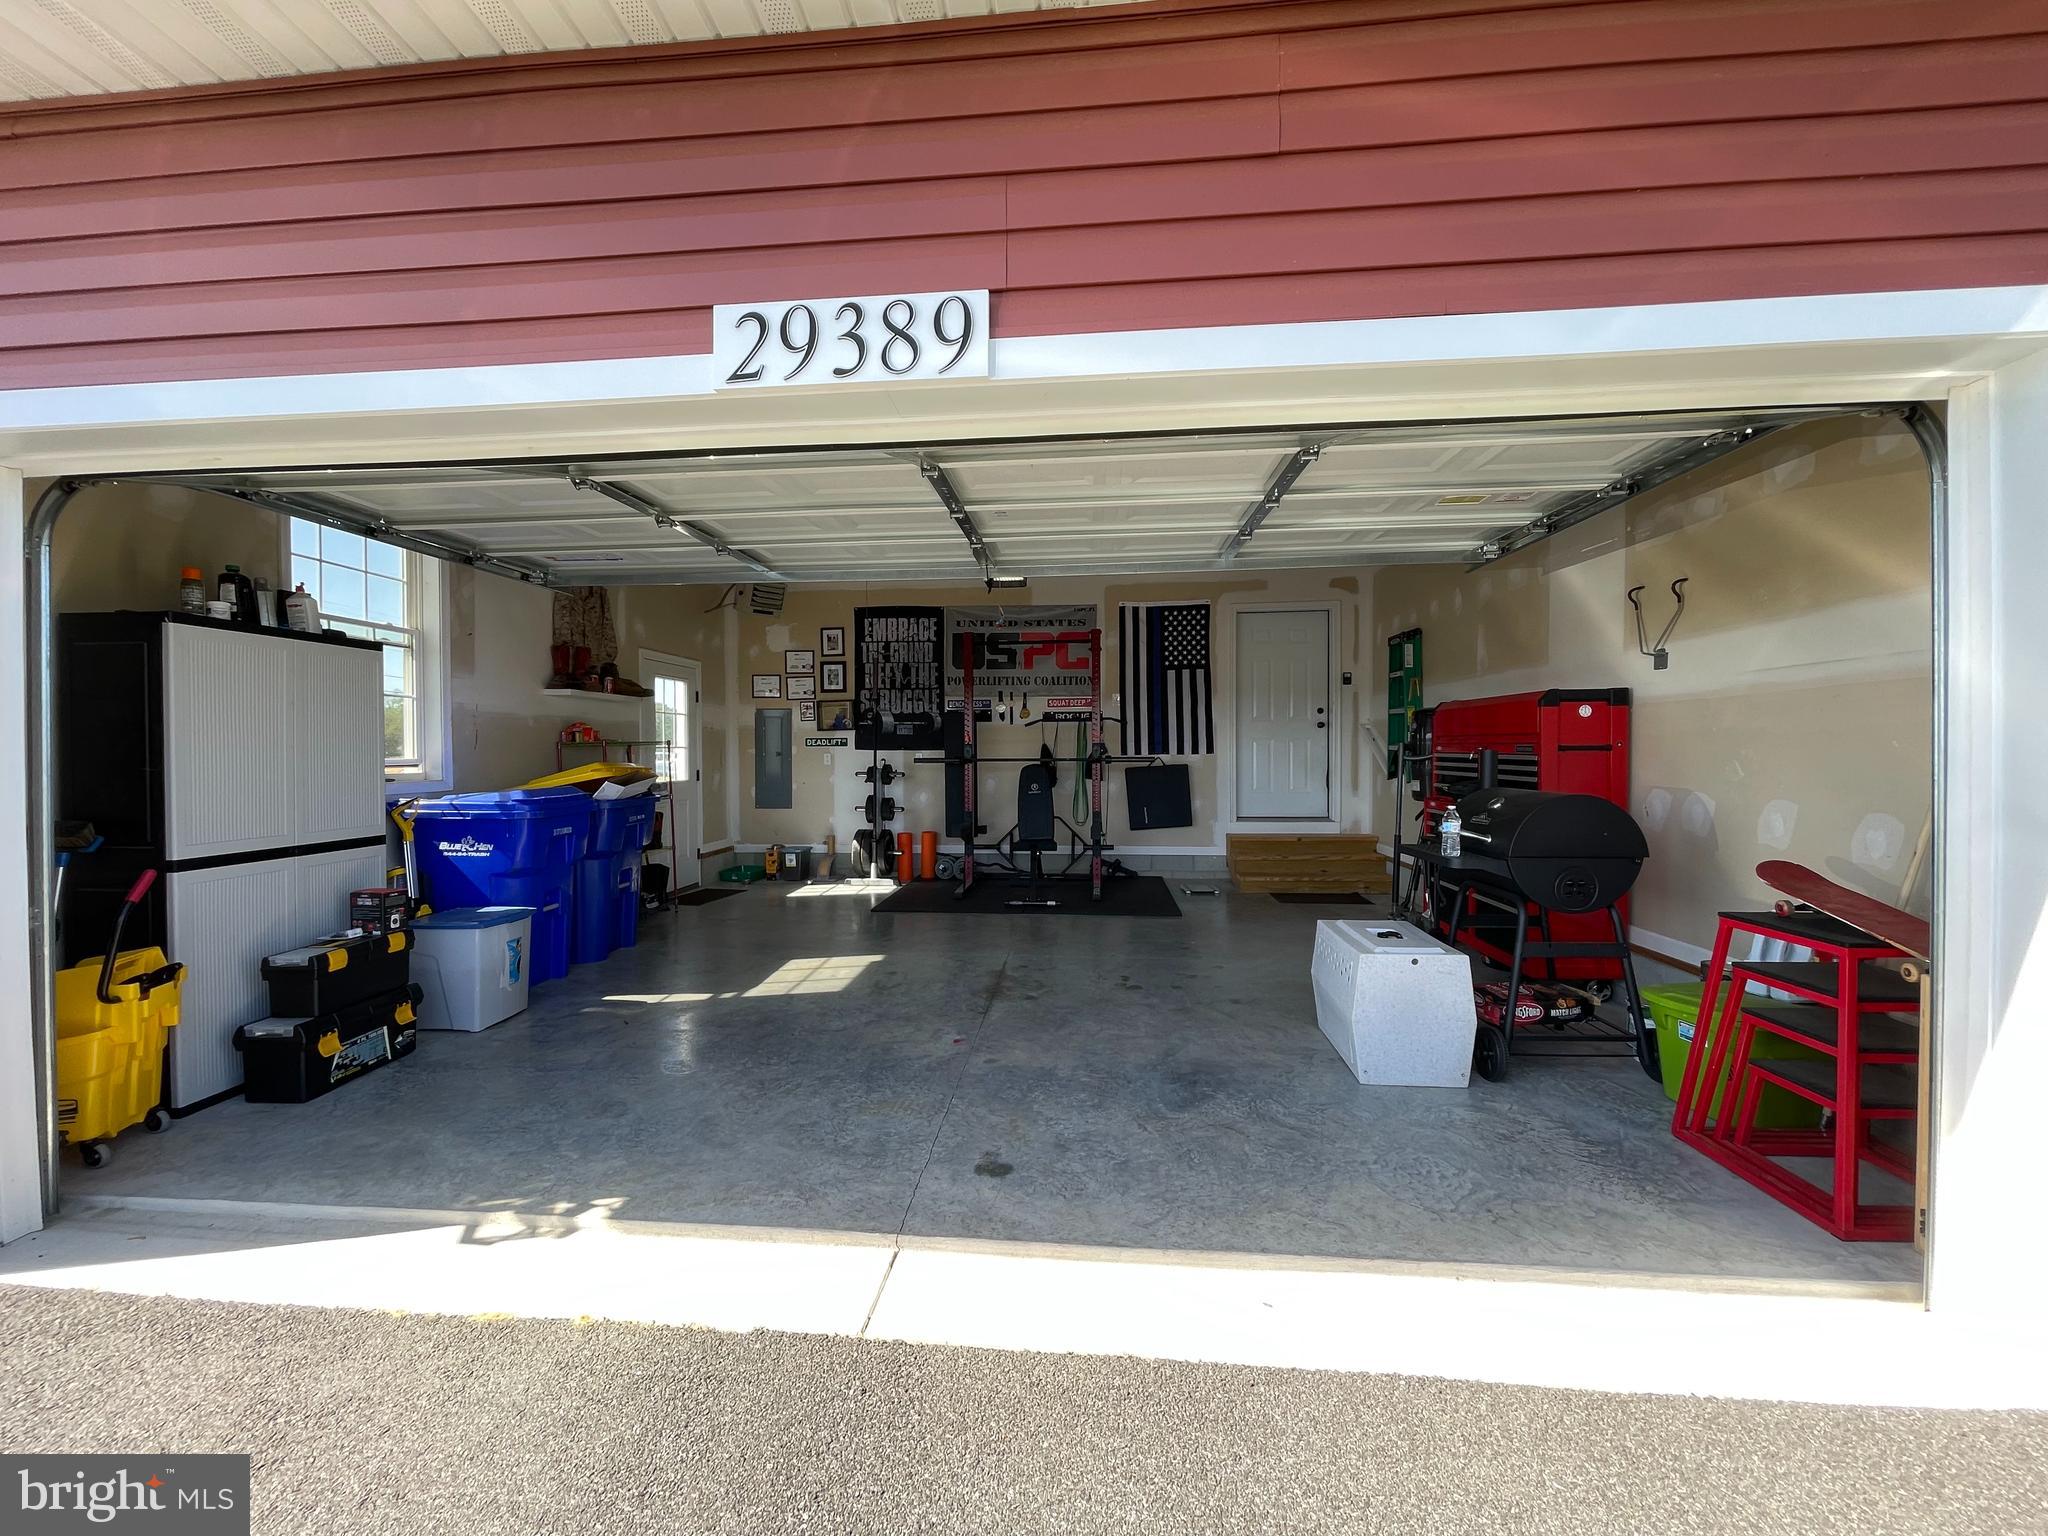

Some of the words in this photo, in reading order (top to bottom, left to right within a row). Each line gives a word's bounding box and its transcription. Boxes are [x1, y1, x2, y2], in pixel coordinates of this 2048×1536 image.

[725, 295, 974, 384] 29389
[864, 617, 937, 642] EMBRACE
[1023, 618, 1087, 627] STATES
[861, 641, 886, 664] THE
[889, 641, 935, 663] GRIND
[864, 663, 903, 689] DEFY
[909, 663, 939, 689] THE
[947, 676, 1031, 686] POERLIFTING
[860, 689, 941, 715] SRUGGLE
[1048, 699, 1069, 707] SQUAT
[1070, 699, 1086, 707] DEEP
[806, 738, 842, 746] DEADLIFT
[1515, 1005, 1541, 1019] NGSFORD
[1550, 1008, 1569, 1017] MATCH
